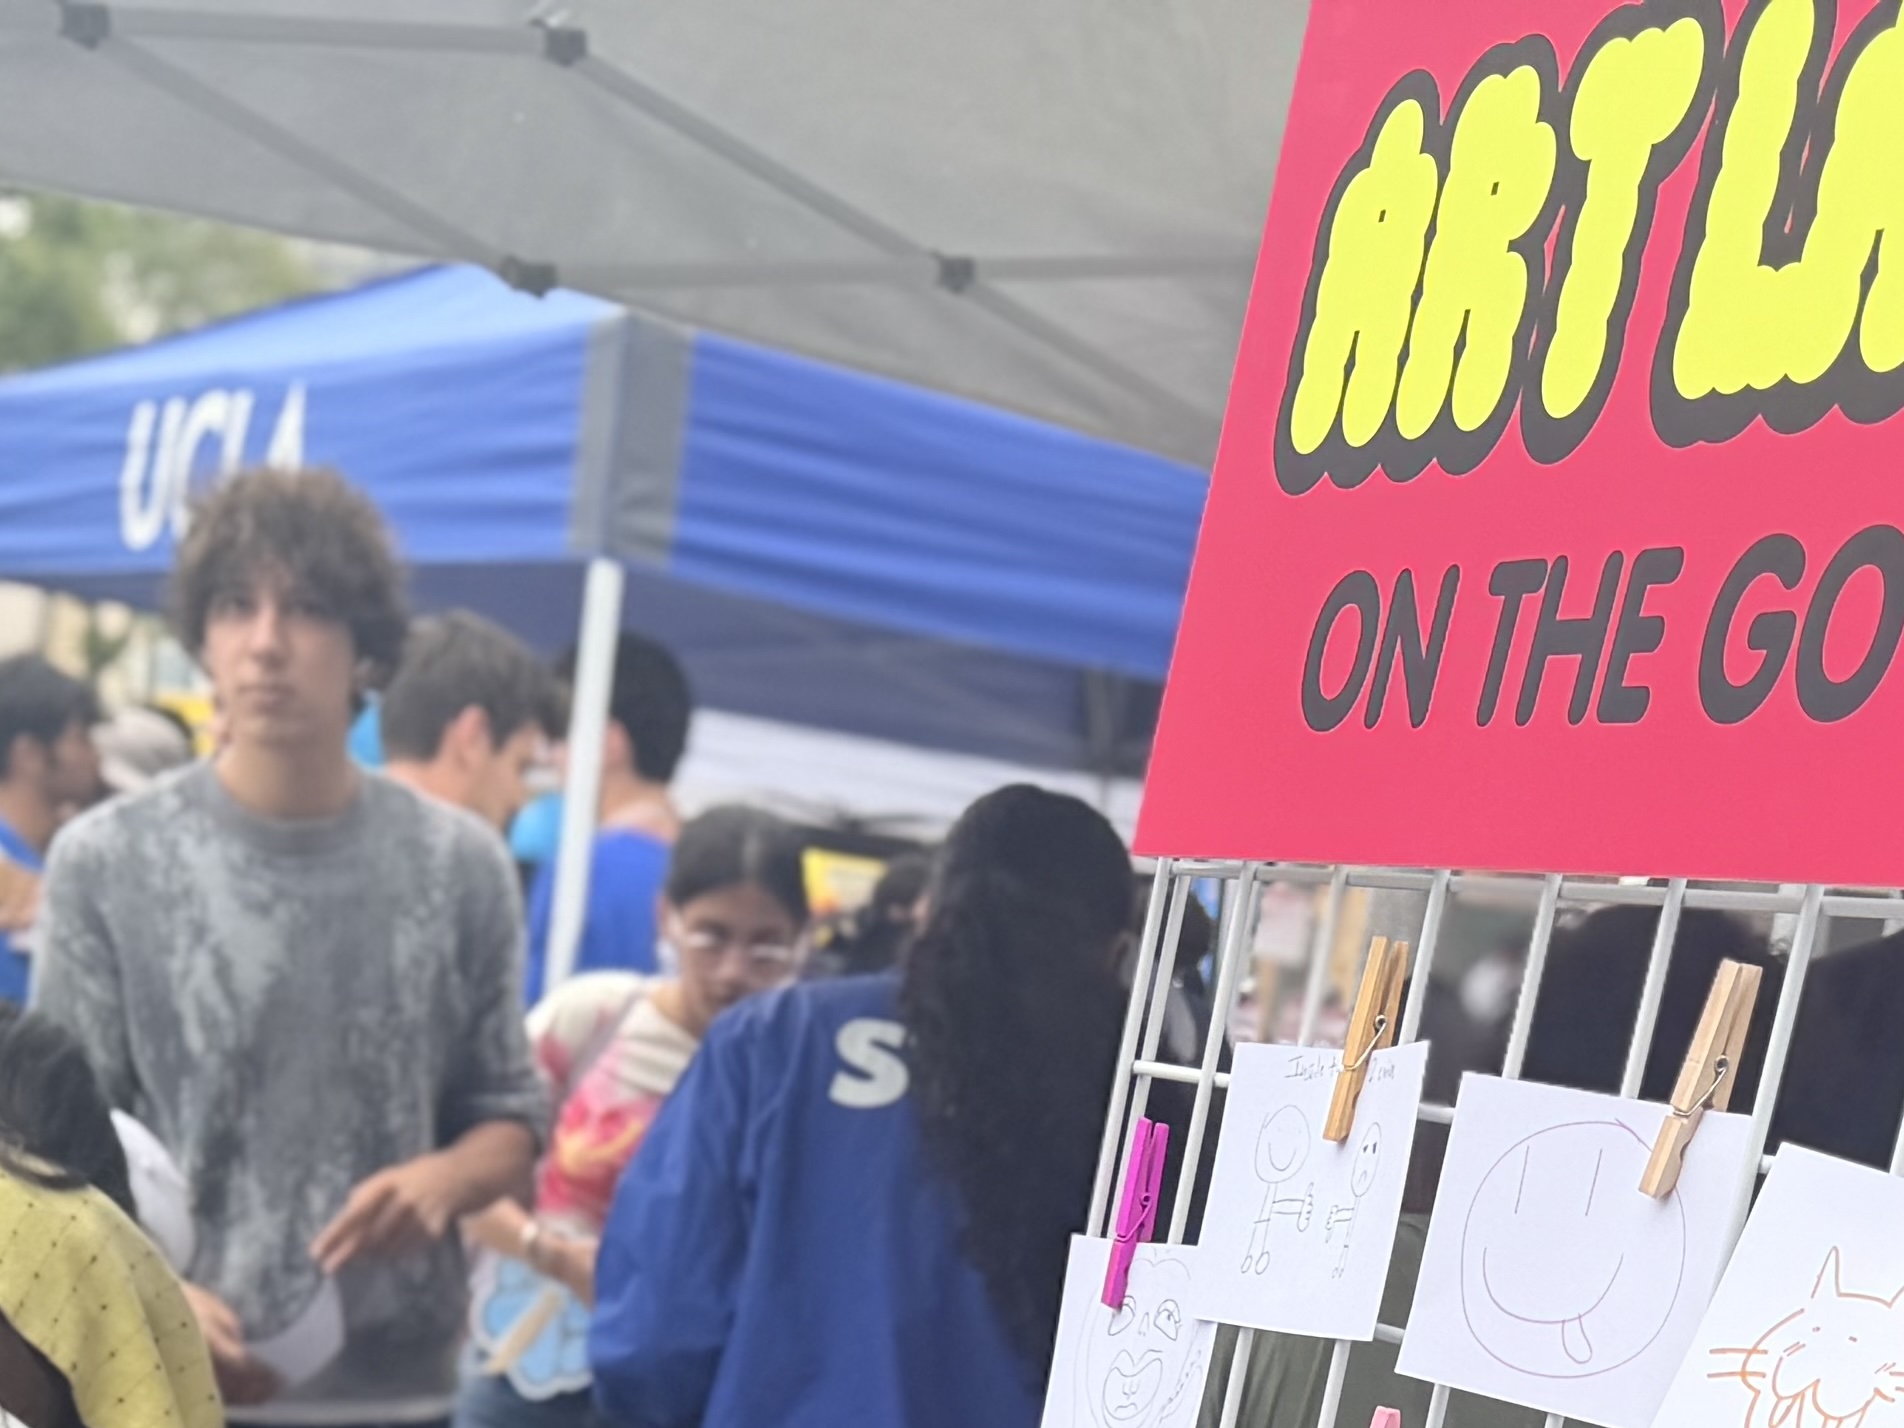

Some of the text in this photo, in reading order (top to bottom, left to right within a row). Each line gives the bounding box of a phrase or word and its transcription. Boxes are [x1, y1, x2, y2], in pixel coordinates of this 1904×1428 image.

[1281, 8, 1714, 475] ART
[1301, 565, 1460, 732] ON
[1476, 546, 1684, 729] THE
